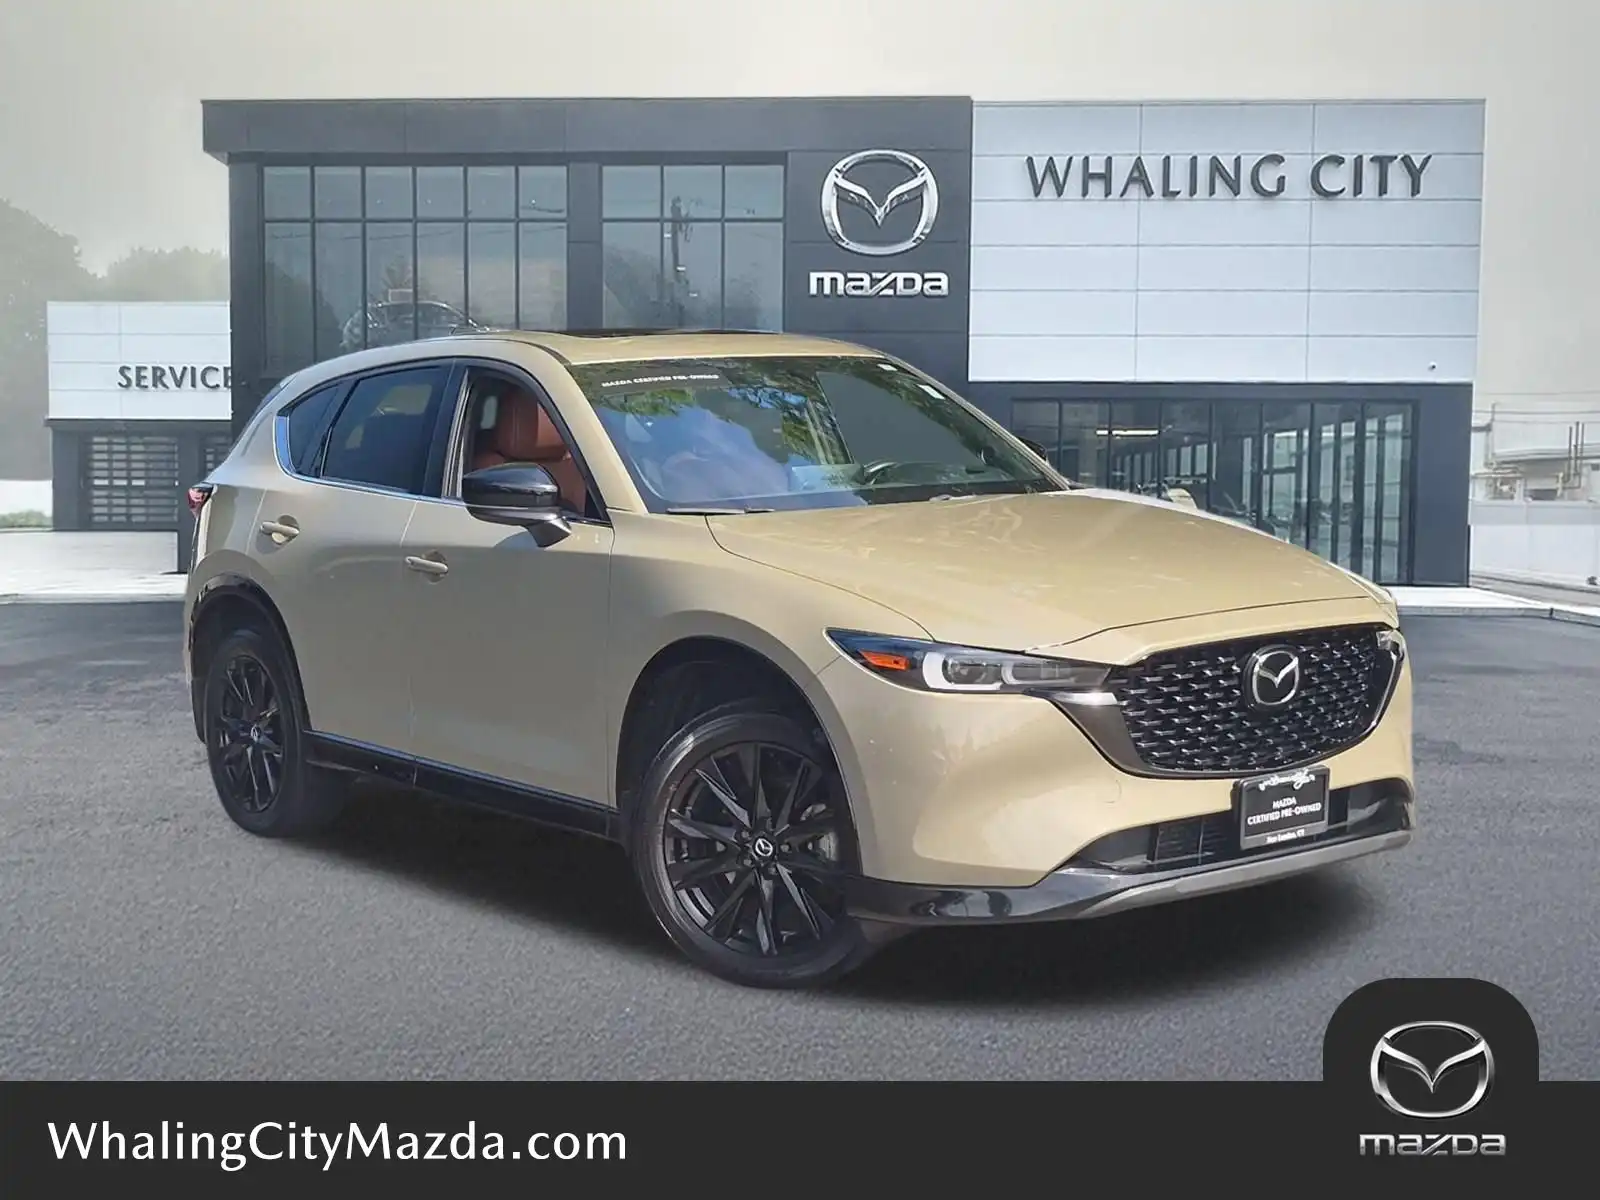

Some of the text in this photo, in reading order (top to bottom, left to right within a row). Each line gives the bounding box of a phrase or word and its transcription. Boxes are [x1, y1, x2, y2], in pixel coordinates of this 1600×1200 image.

[1025, 153, 1433, 199] WHALING CITY
[117, 365, 232, 390] SERVICE
[1247, 802, 1321, 825] CERTIFIED PRE-OWNED
[1272, 797, 1296, 809] MAZDA
